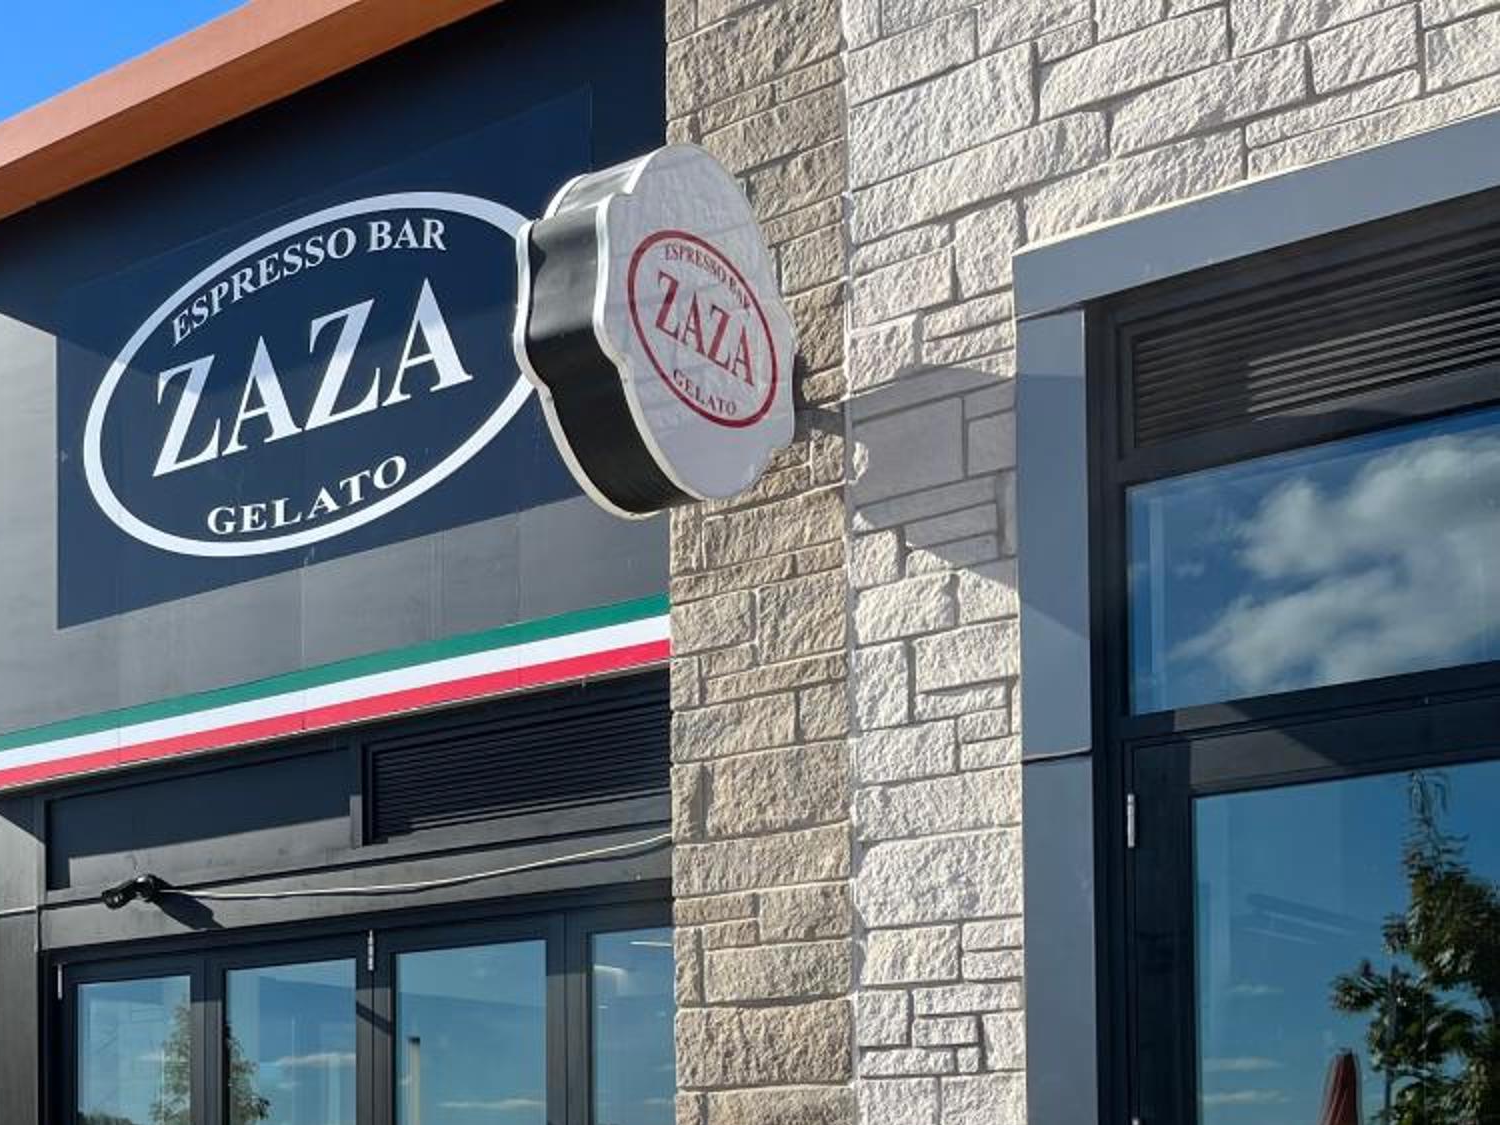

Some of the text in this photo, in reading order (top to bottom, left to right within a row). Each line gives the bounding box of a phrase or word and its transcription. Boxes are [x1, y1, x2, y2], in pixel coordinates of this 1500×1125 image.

[171, 216, 446, 347] ESPRESSO BAR
[664, 244, 751, 314] ESPRESSO BAR
[152, 277, 473, 477] ZAZA
[655, 270, 755, 387] ZAZA
[673, 368, 737, 415] GELATO
[207, 455, 407, 535] GELATO
